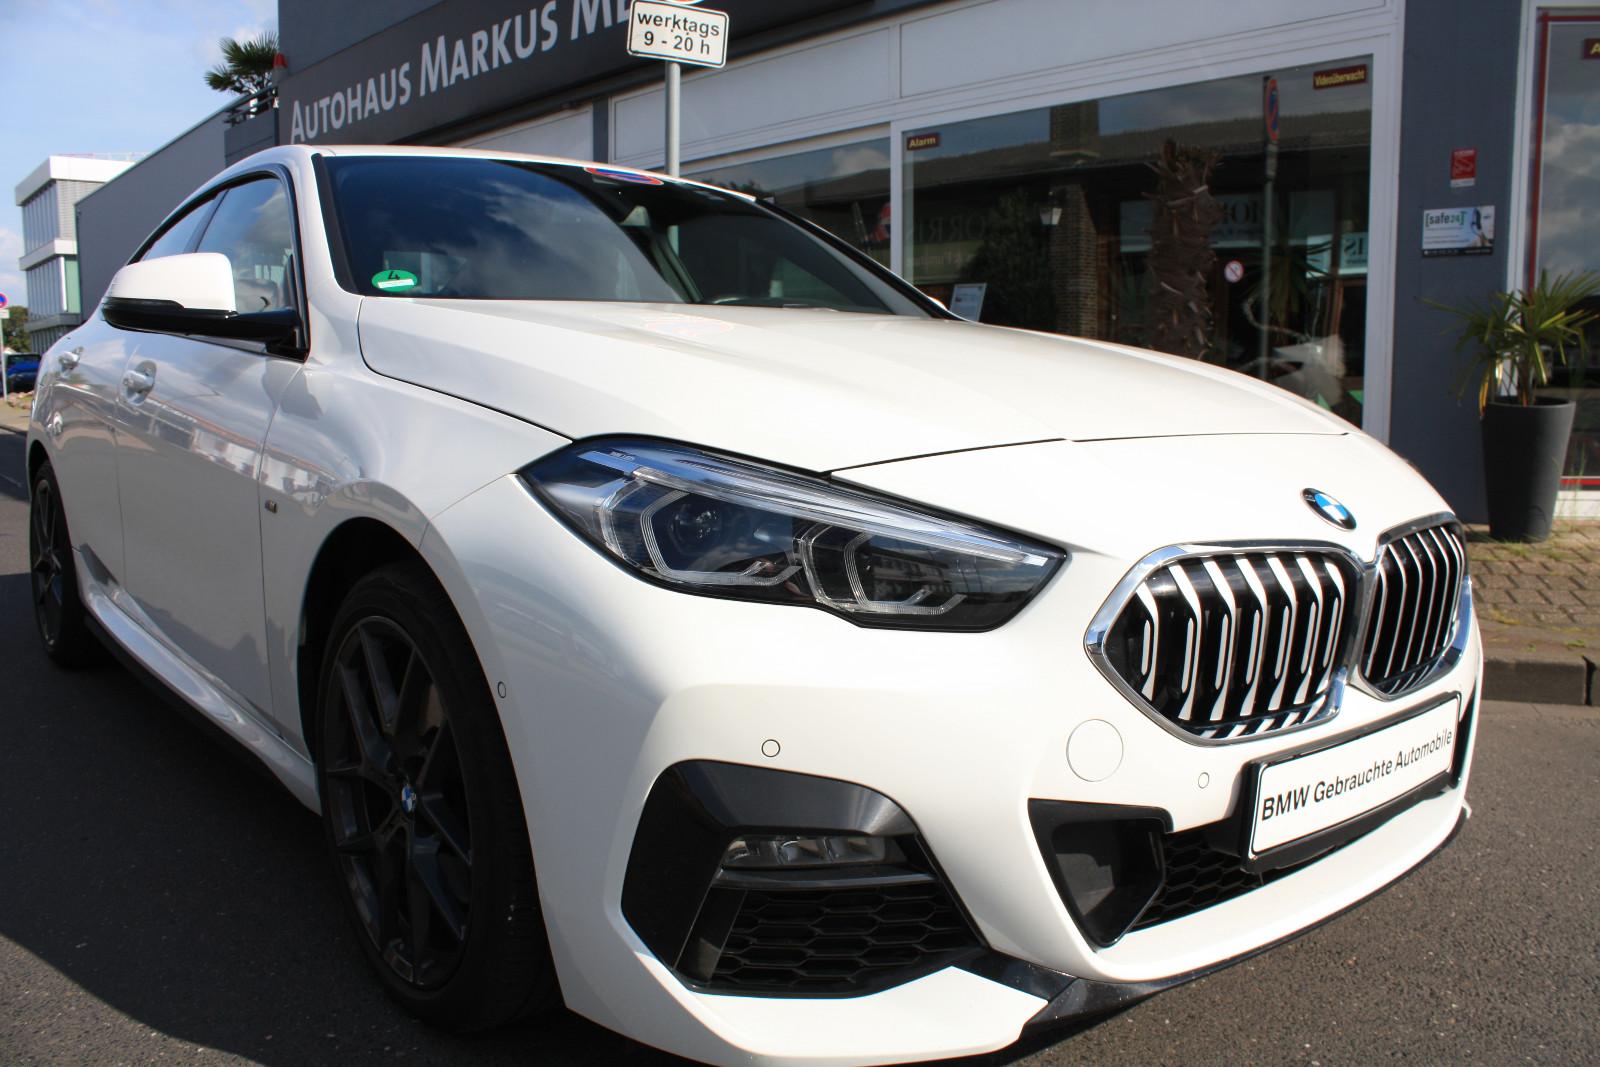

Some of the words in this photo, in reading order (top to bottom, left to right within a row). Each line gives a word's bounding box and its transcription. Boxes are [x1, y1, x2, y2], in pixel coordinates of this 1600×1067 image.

[637, 13, 721, 38] werktags
[644, 31, 655, 46] 9
[673, 35, 694, 52] 20
[700, 39, 711, 55] h
[290, 62, 412, 145] AUTOHAUS
[420, 0, 559, 97] MARKUS
[909, 137, 937, 149] Alarm
[1261, 784, 1311, 821] BMW
[1313, 760, 1393, 803] Gebrauchte
[1394, 728, 1453, 771] Automobile
